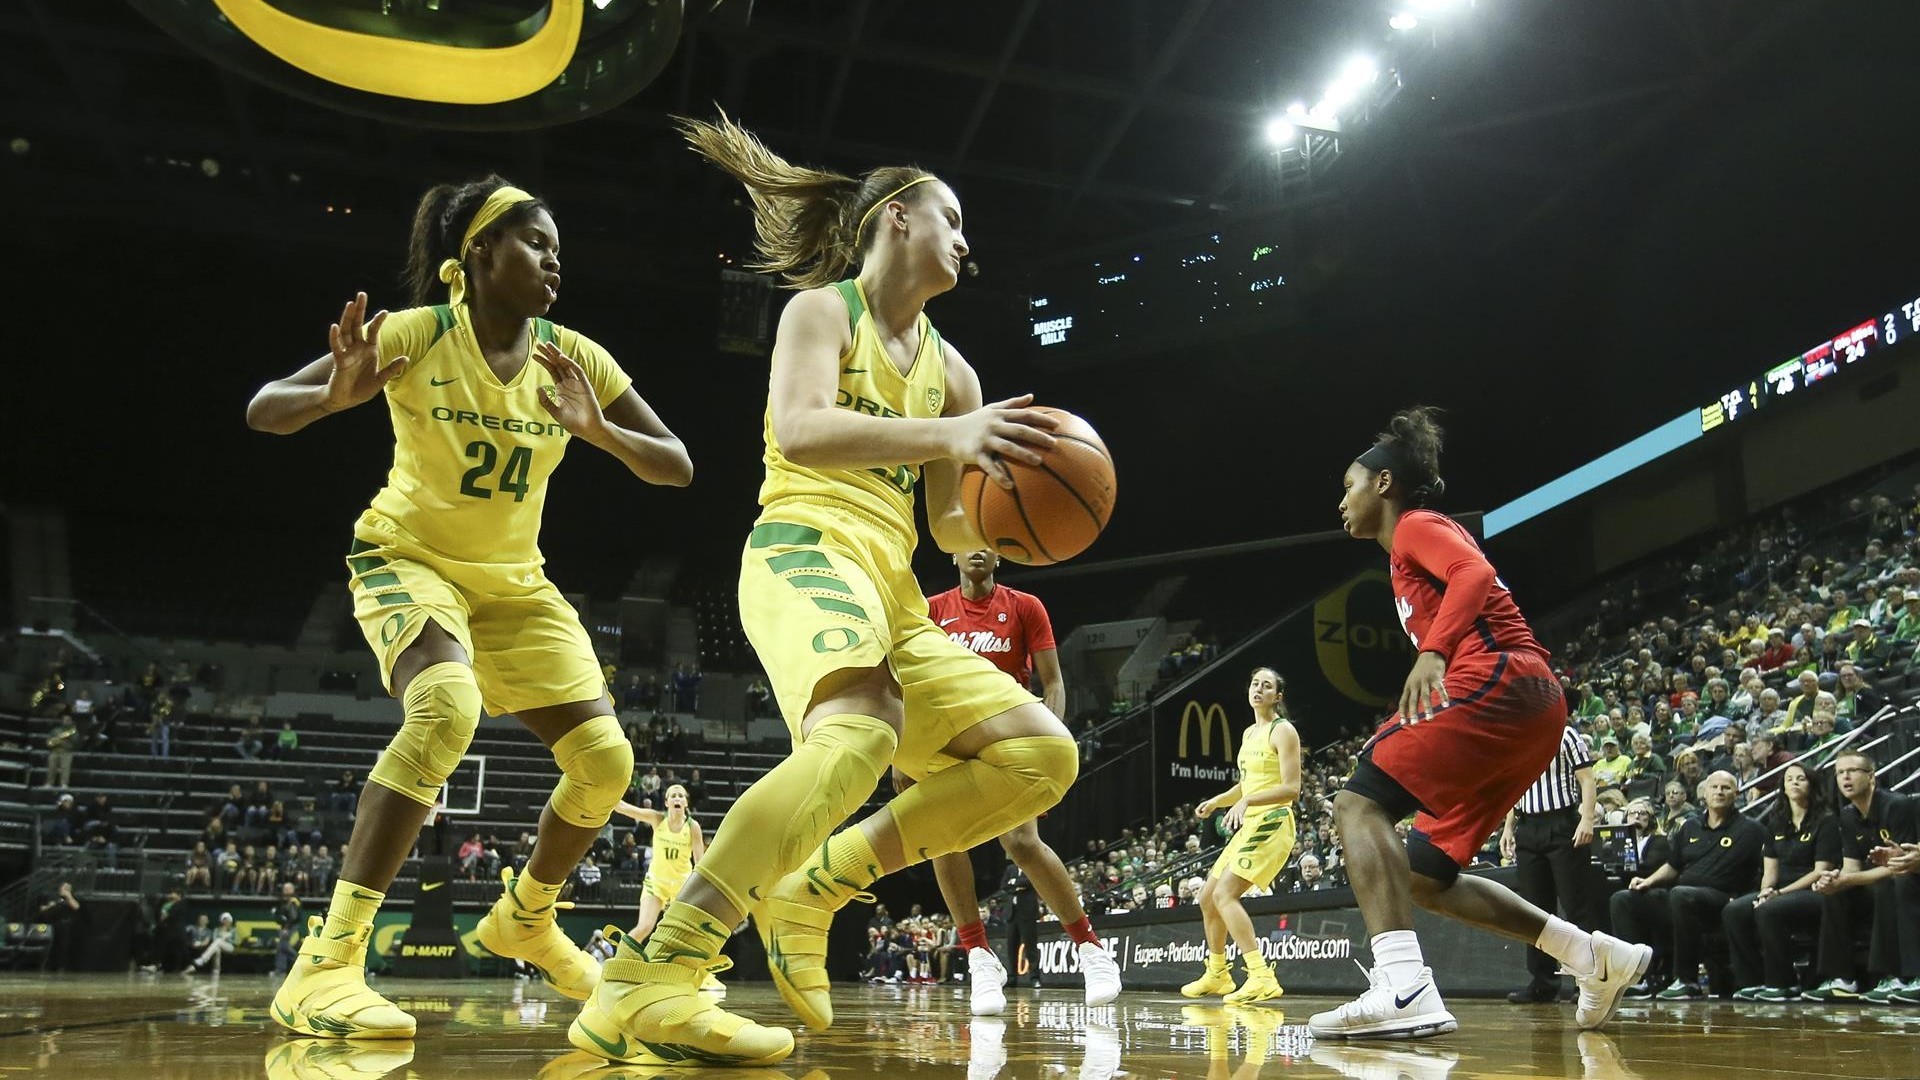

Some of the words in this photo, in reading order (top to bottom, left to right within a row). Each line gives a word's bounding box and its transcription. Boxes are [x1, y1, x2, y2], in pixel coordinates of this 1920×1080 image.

[1034, 316, 1073, 335] MUSCLE
[1883, 313, 1895, 330] 2
[1040, 330, 1066, 346] MILK
[1885, 328, 1897, 344] 0
[1846, 341, 1865, 363] 24
[1750, 396, 1757, 409] 1
[432, 407, 565, 437] OREGON
[460, 440, 533, 503] 24
[969, 631, 1012, 653] Miss
[1171, 763, 1191, 778] i'm
[1194, 765, 1230, 781] lovin'
[664, 847, 679, 859] 10
[401, 945, 456, 958] BI-MART
[1134, 944, 1163, 968] Eugene
[1167, 939, 1206, 963] Portland
